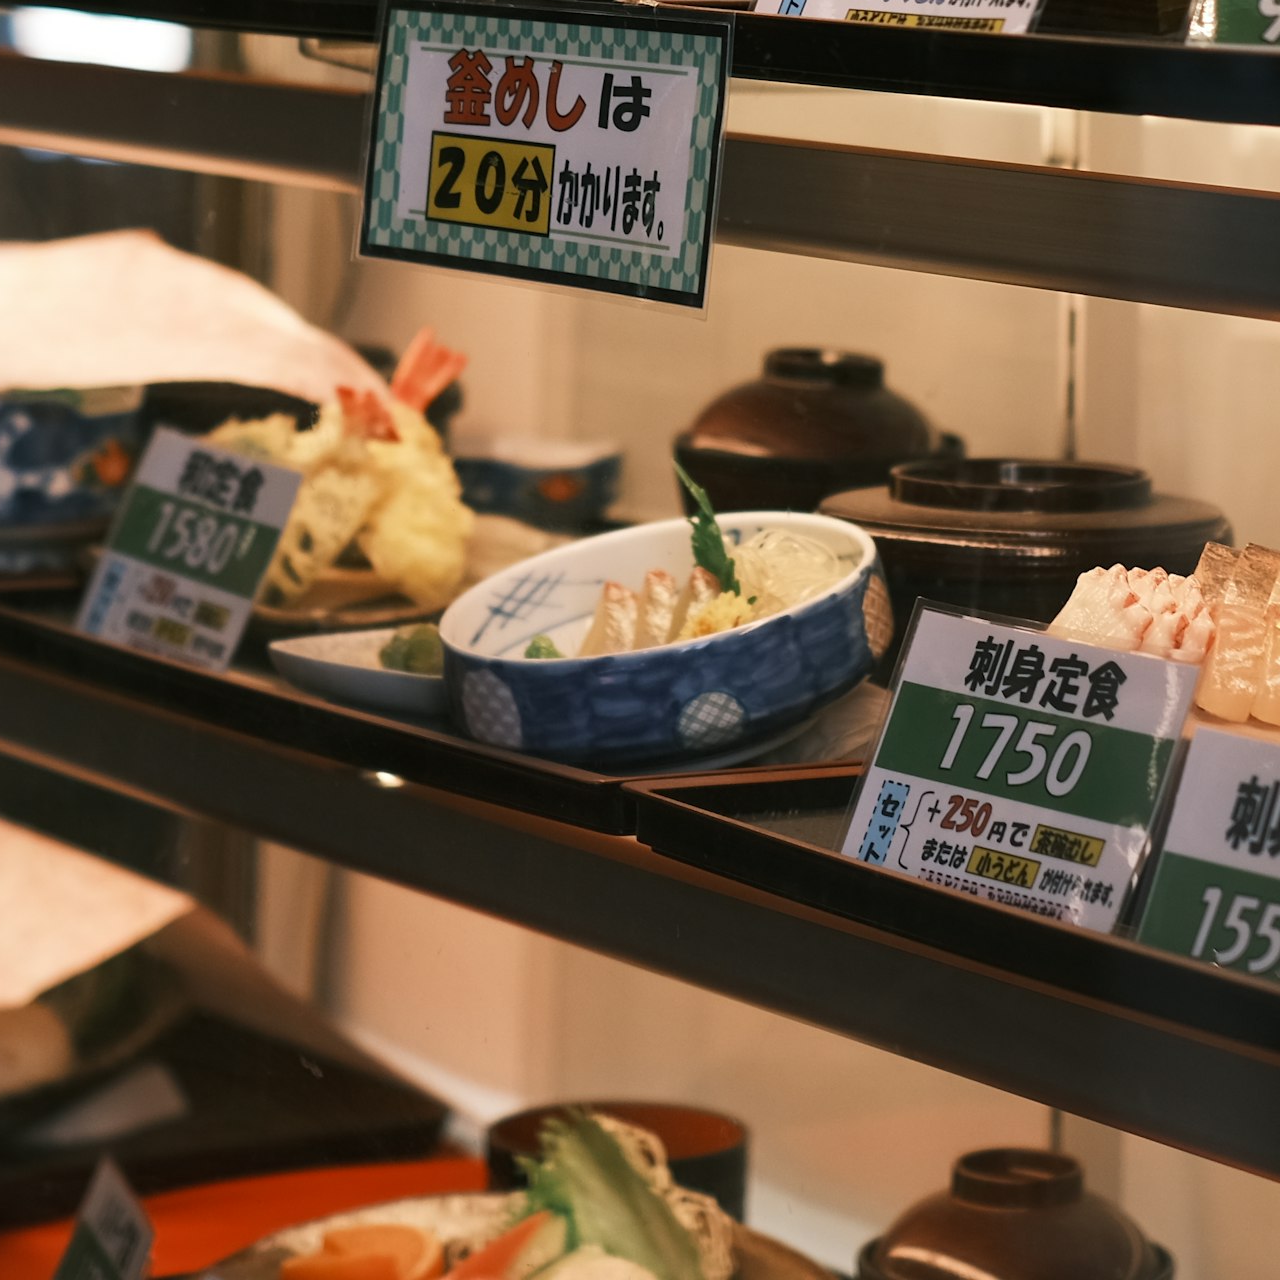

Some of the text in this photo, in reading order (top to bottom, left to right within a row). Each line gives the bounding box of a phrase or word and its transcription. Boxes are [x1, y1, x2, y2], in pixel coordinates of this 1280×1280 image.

[443, 47, 653, 133] 釜めしは
[964, 635, 1128, 722] 刺身定食
[938, 703, 1093, 798] 1750
[864, 793, 900, 863] セット
